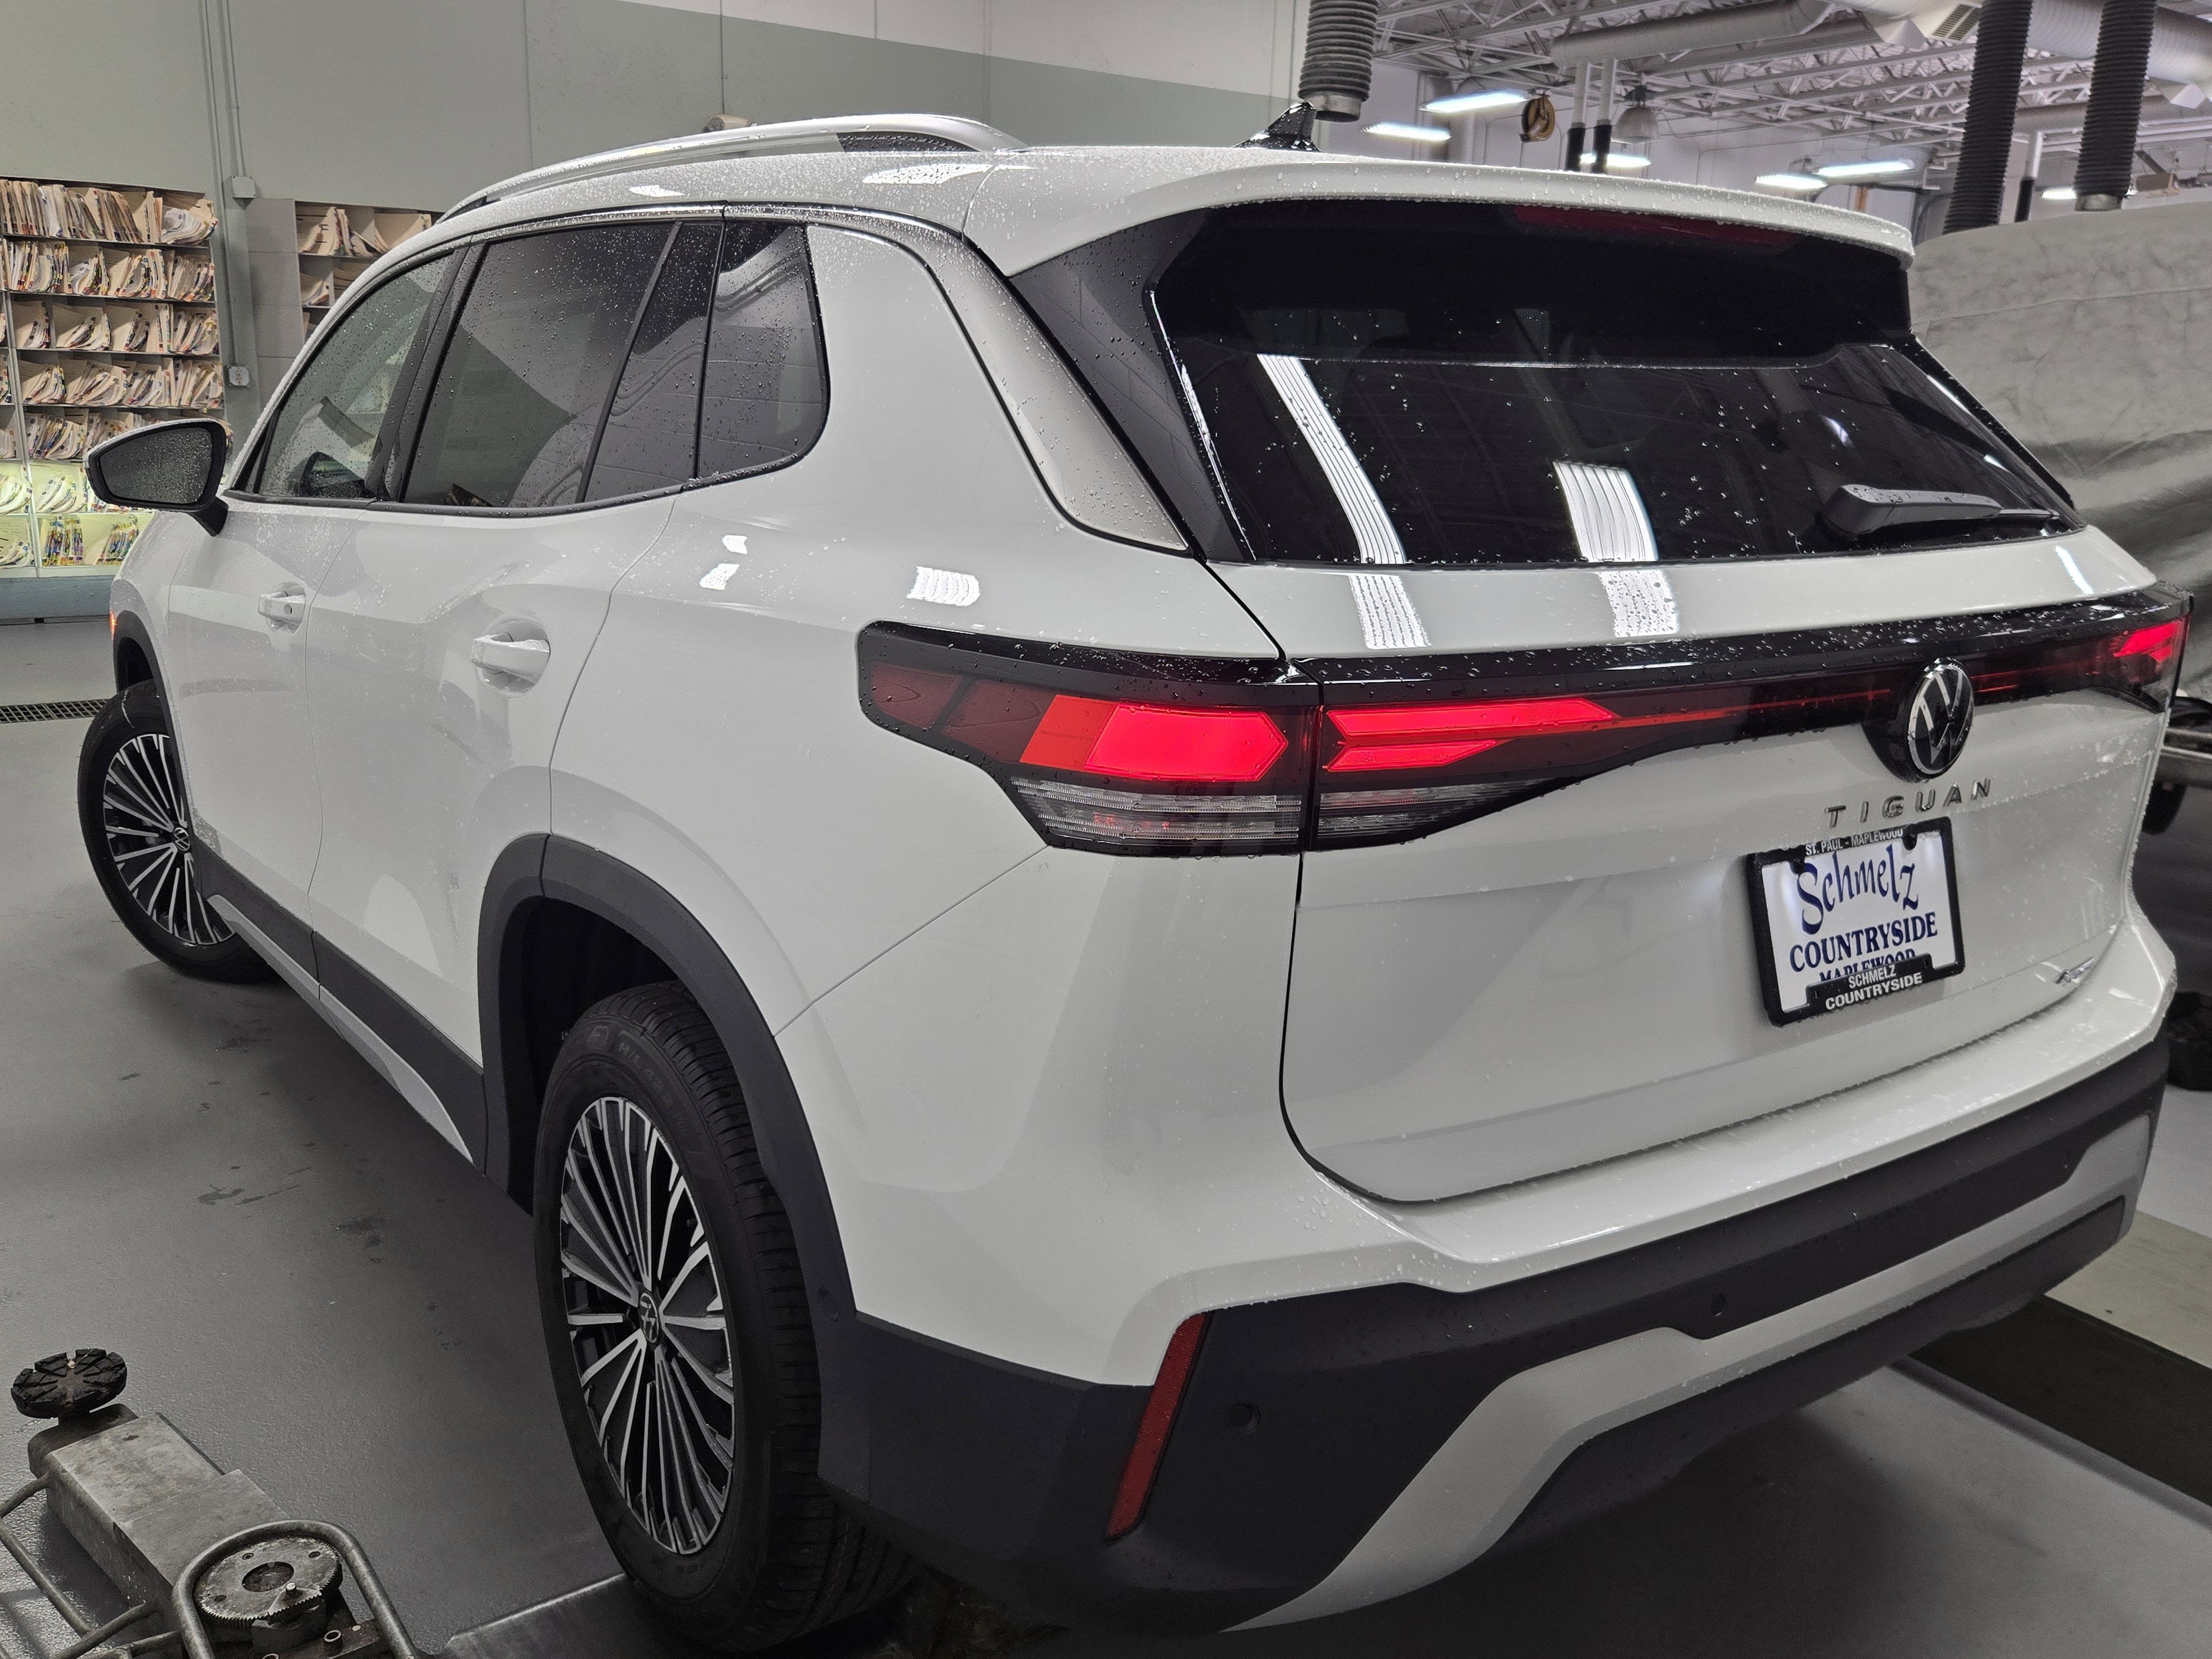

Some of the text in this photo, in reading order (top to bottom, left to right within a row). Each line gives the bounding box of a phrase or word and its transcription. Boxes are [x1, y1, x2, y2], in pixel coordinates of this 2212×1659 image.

[1824, 778, 1991, 829] TIGUAN
[1805, 841, 1819, 855] ST.
[1820, 838, 1844, 853] PAUL
[1850, 828, 1903, 847] MAPLEWOOD
[1796, 843, 1919, 935] Schmelz
[1790, 911, 1938, 973] COUNTRYSIDE
[1825, 972, 1923, 1010] COUNTRYSIDE
[1848, 964, 1897, 989] SCHMELZ
